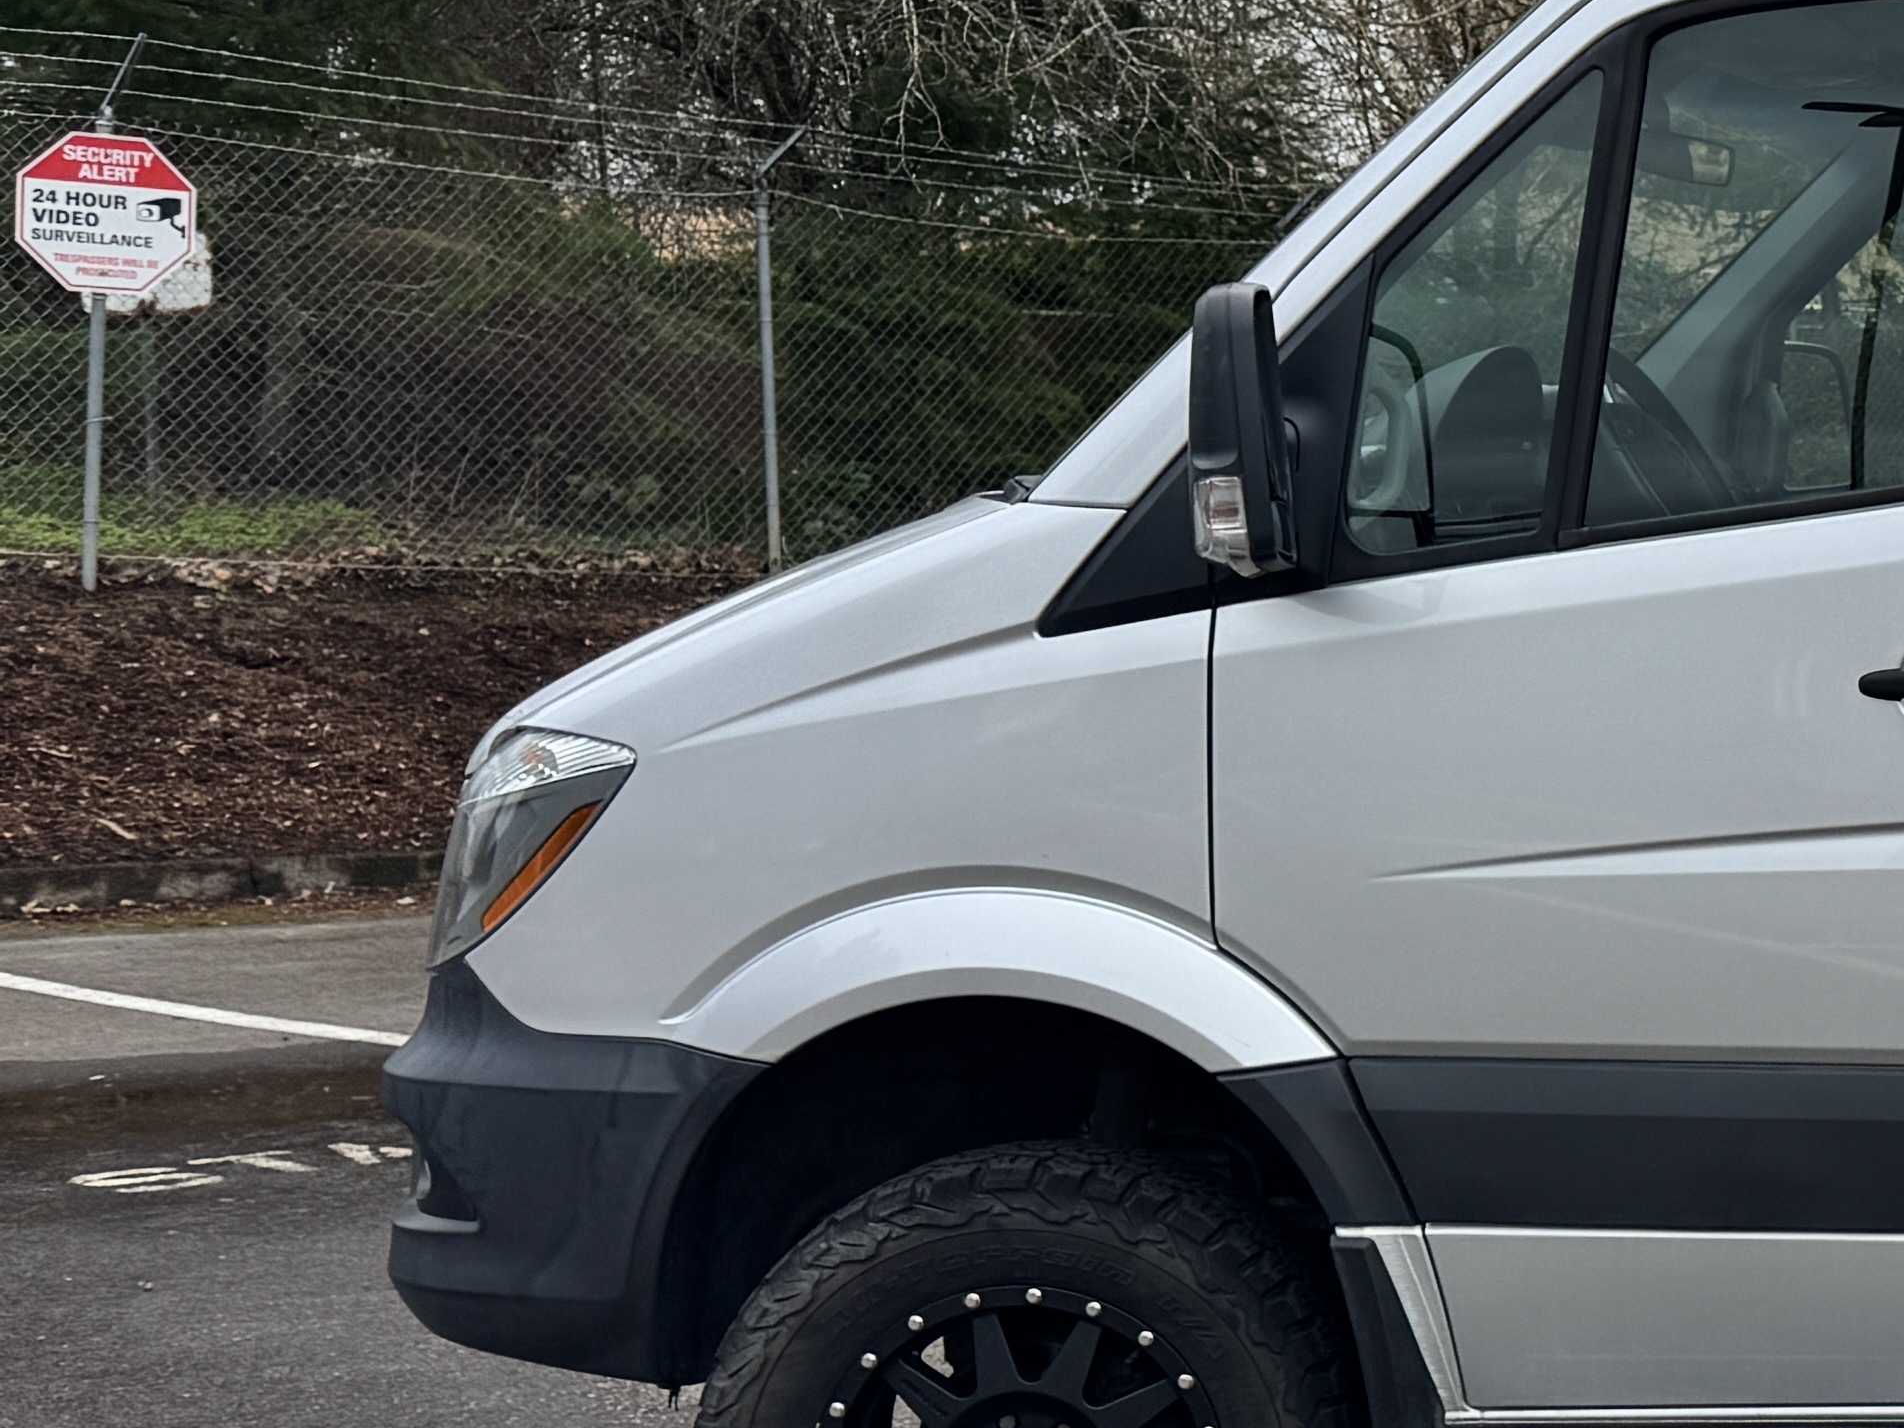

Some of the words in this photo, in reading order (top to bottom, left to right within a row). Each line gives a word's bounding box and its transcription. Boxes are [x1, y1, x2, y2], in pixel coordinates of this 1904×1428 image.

[63, 145, 154, 167] SECURITY
[78, 164, 139, 183] ALERT
[32, 189, 57, 203] 24
[66, 192, 127, 210] HOUR
[32, 208, 99, 227] VIDEO
[31, 228, 154, 248] SURVEILLANCE
